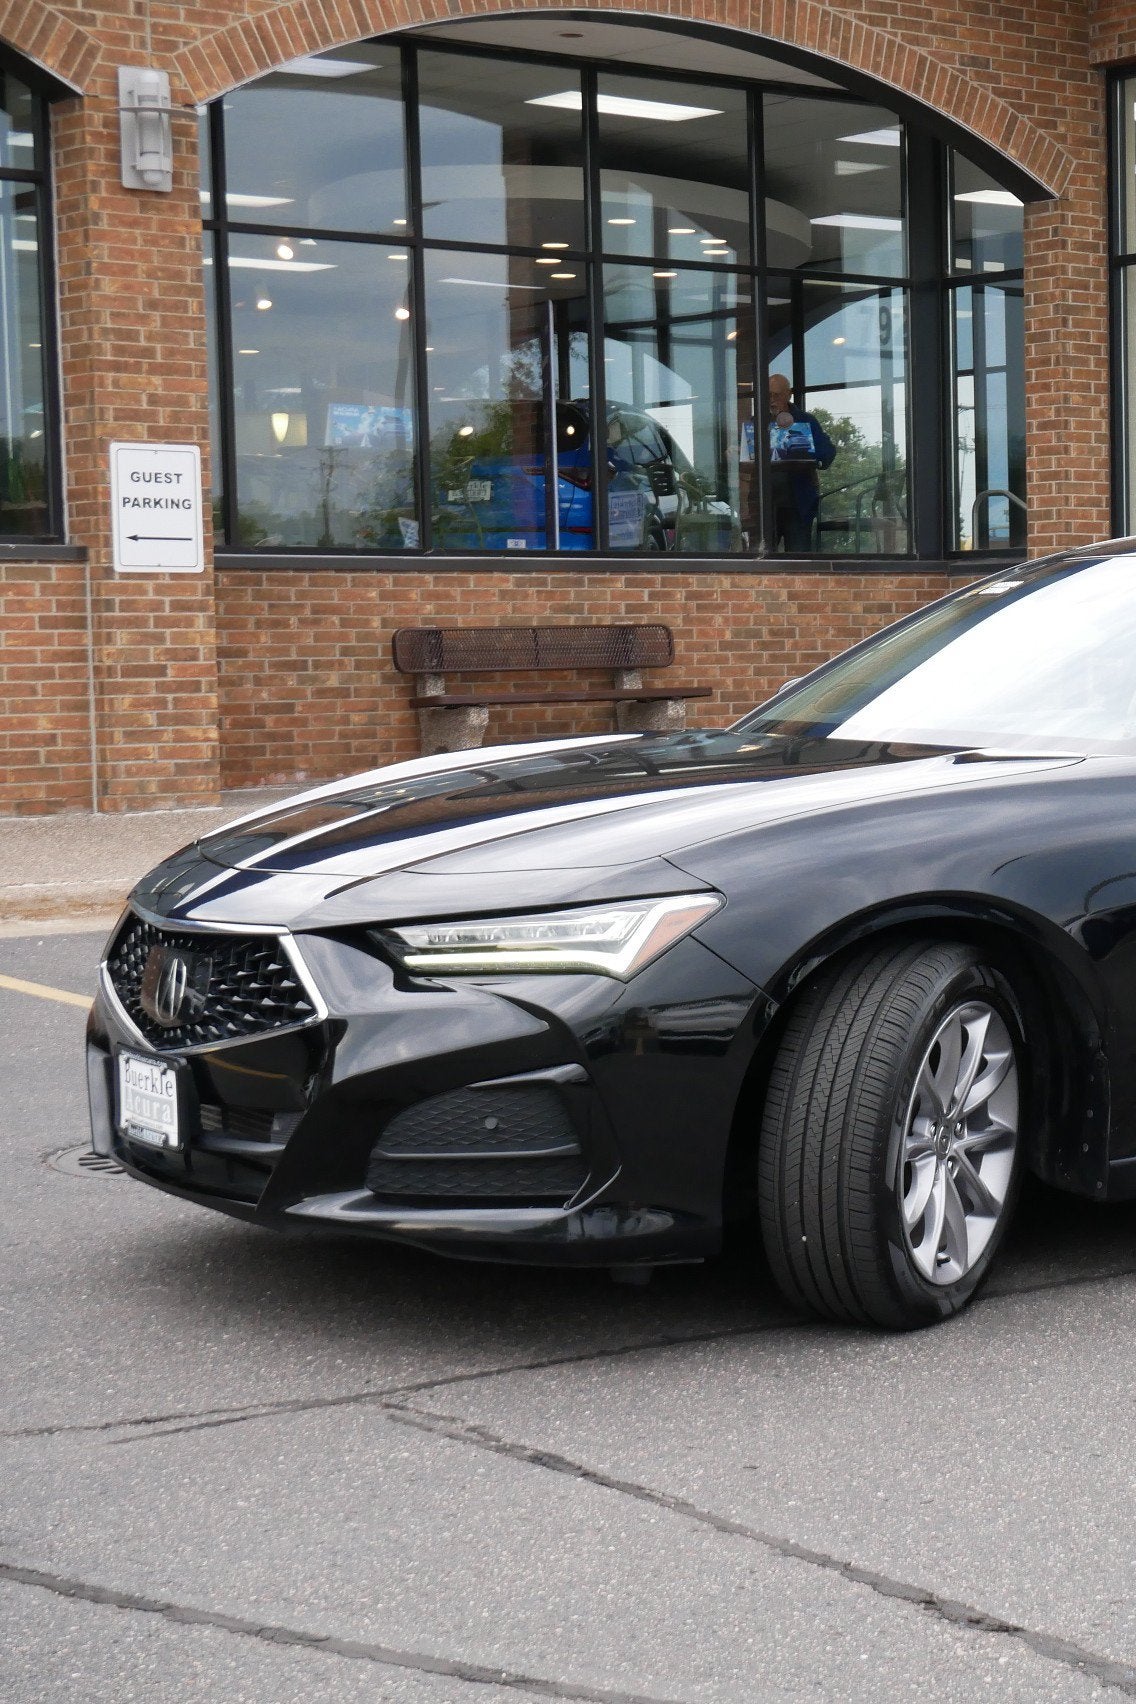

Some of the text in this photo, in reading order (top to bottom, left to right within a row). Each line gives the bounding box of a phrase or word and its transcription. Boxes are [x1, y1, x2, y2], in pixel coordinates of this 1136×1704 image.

[130, 471, 182, 484] GUEST
[122, 496, 192, 510] PARKING
[125, 1061, 173, 1098] Buerkle
[125, 1086, 173, 1124] Acura
